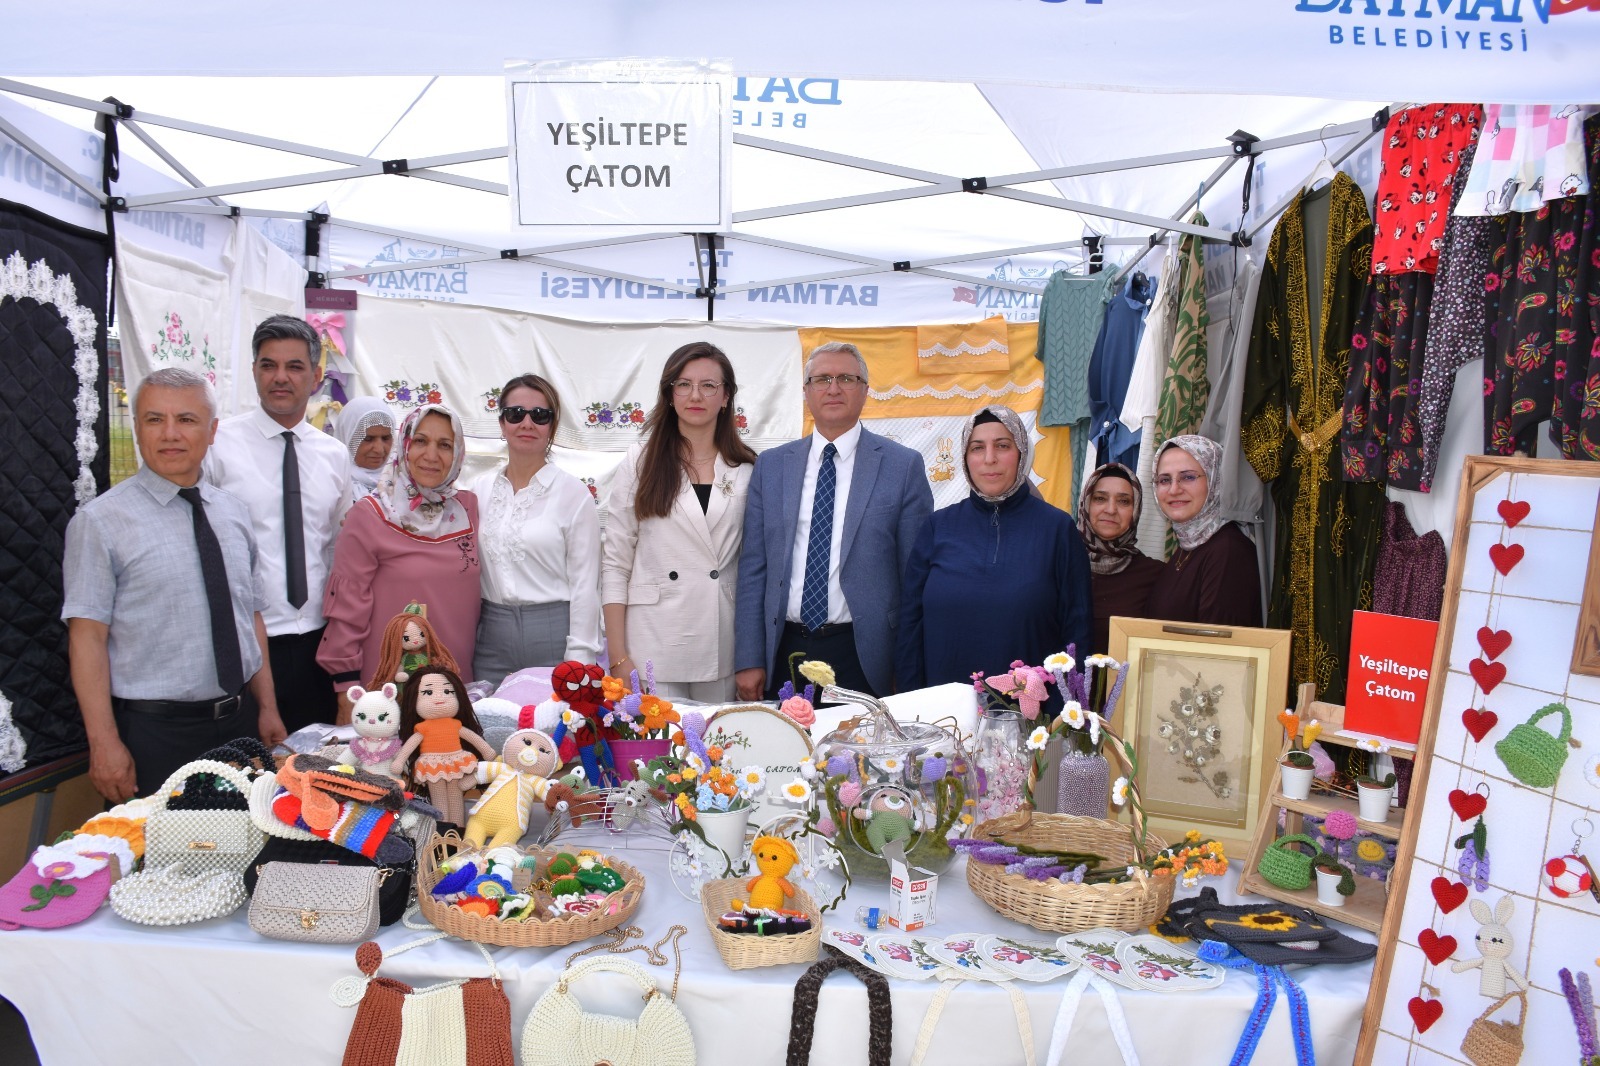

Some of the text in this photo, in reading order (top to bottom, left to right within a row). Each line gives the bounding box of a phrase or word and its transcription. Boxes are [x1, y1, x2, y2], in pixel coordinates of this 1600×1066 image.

[1329, 25, 1528, 51] BELEDİYESİ
[546, 116, 688, 151] YEŞİLTEPE
[566, 164, 671, 193] ÇATOM
[1359, 654, 1429, 680] Yeşiltepe
[1365, 680, 1416, 702] Çatom
